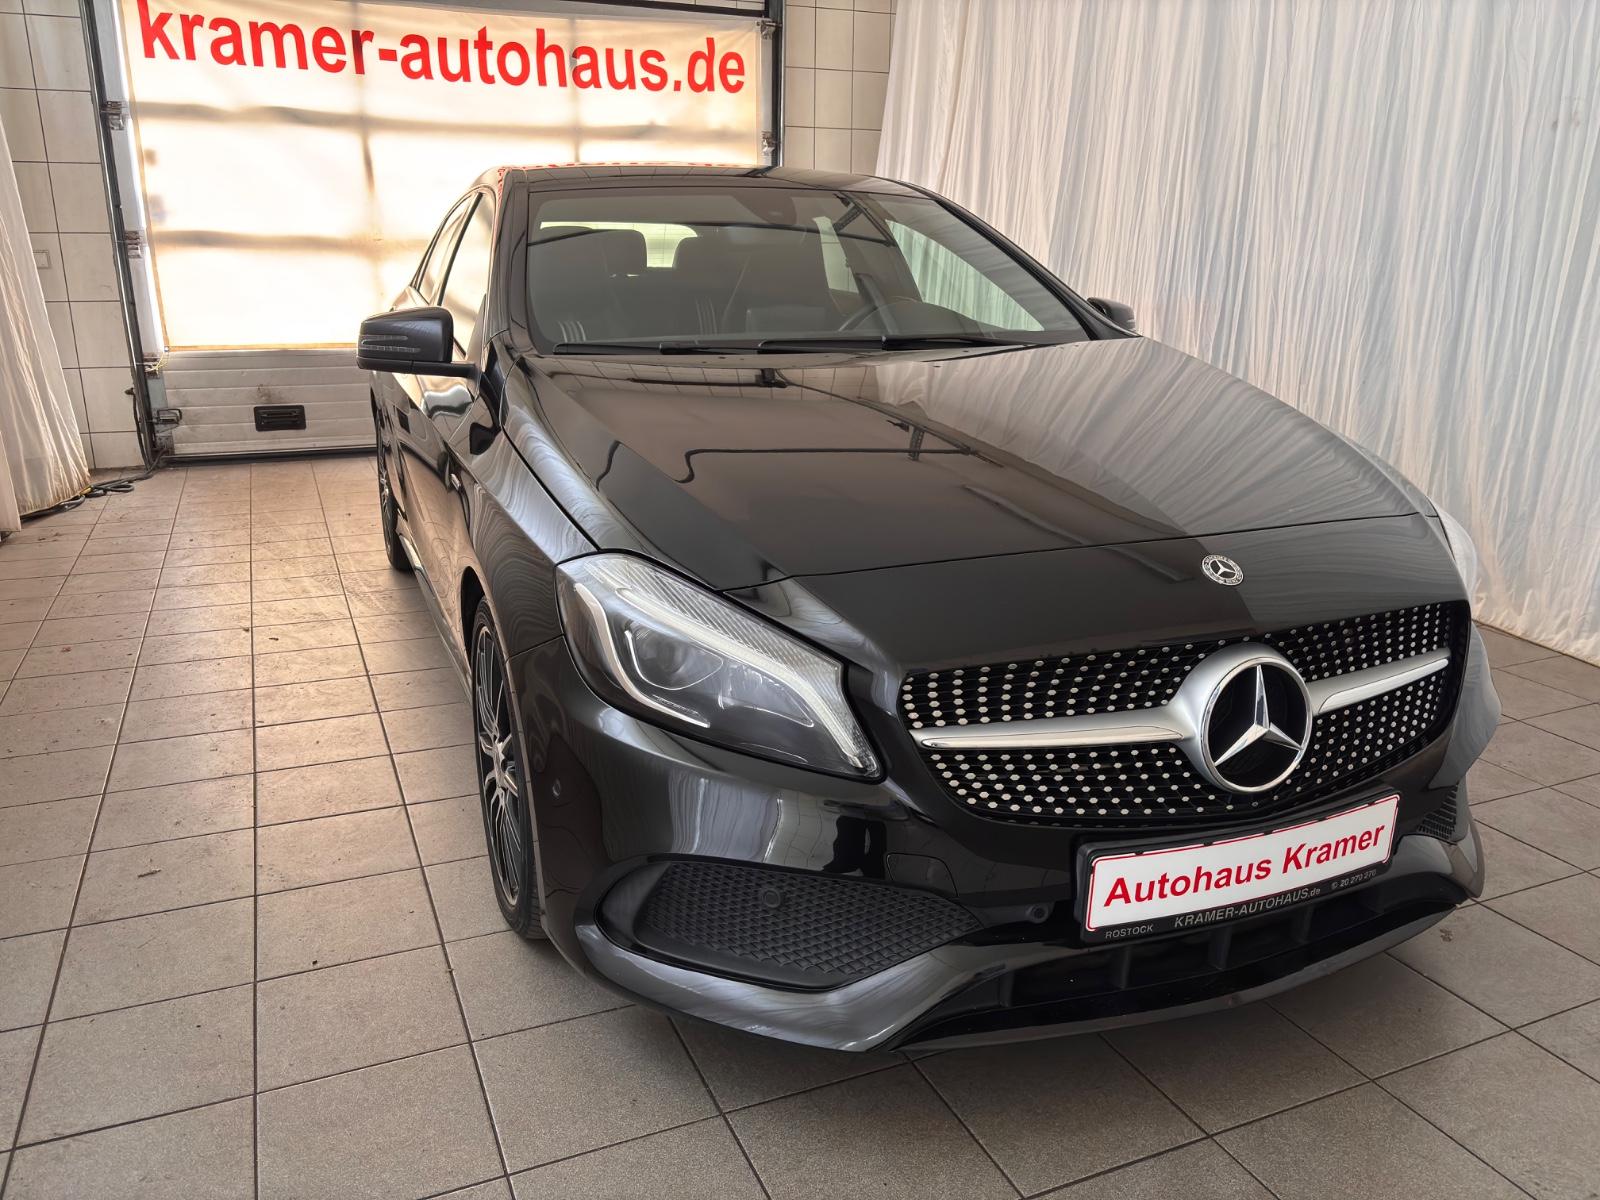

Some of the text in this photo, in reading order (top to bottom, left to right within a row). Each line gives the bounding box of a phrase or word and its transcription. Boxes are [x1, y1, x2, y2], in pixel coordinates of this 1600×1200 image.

[136, 0, 746, 94] kramer-autohaus.de
[1104, 825, 1386, 907] Autohaus Kramer
[1105, 924, 1154, 940] ROSTOCK
[1174, 886, 1322, 928] KRAMER-AUTOHAUS.de
